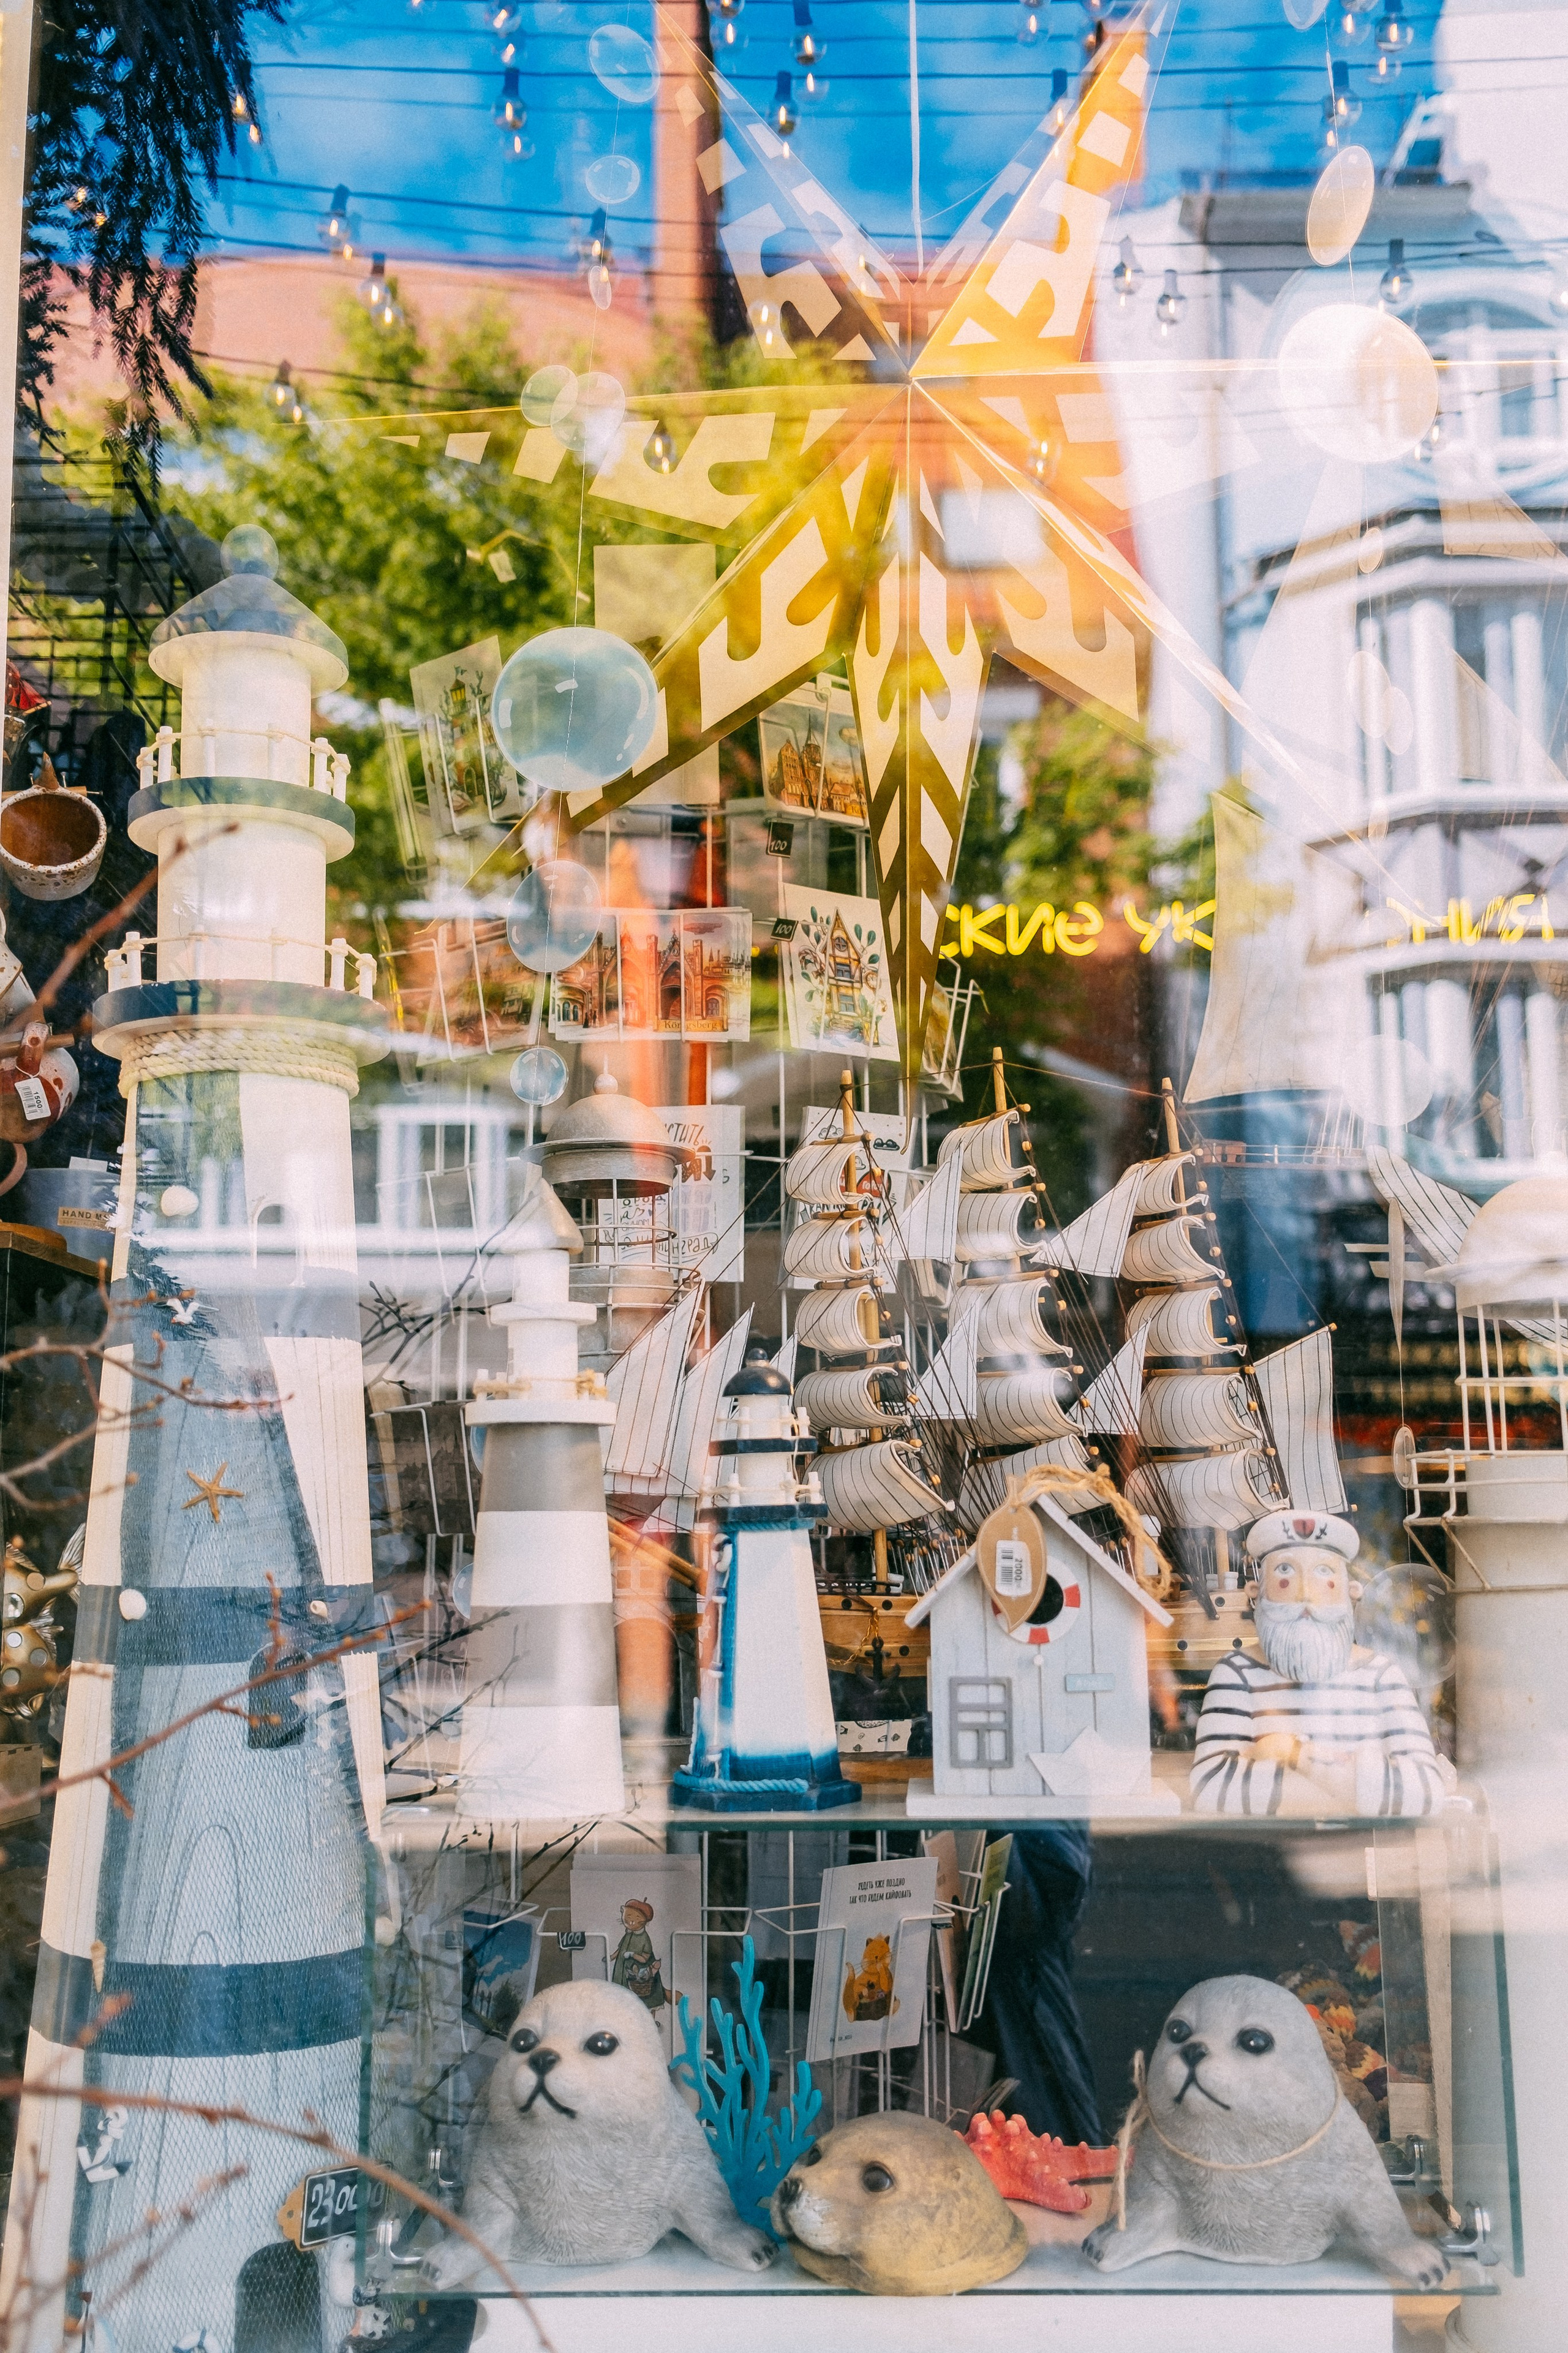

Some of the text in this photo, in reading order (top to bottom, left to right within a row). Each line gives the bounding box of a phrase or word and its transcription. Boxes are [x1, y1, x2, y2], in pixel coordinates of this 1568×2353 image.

[771, 840, 787, 851] 100
[775, 924, 793, 934] 100
[665, 1019, 717, 1030] Köngsberg
[33, 1092, 43, 1108] 1500
[664, 1122, 705, 1146] СТИТЬ
[62, 1210, 91, 1219] HAND
[1014, 1558, 1023, 1581] 2000
[875, 1879, 884, 1888] УЖЕ
[886, 1877, 905, 1887] ПОЗДНО
[858, 1894, 867, 1903] ЧТО
[885, 1889, 912, 1900] КАЙФОВАТЬ
[561, 1932, 582, 1946] 100
